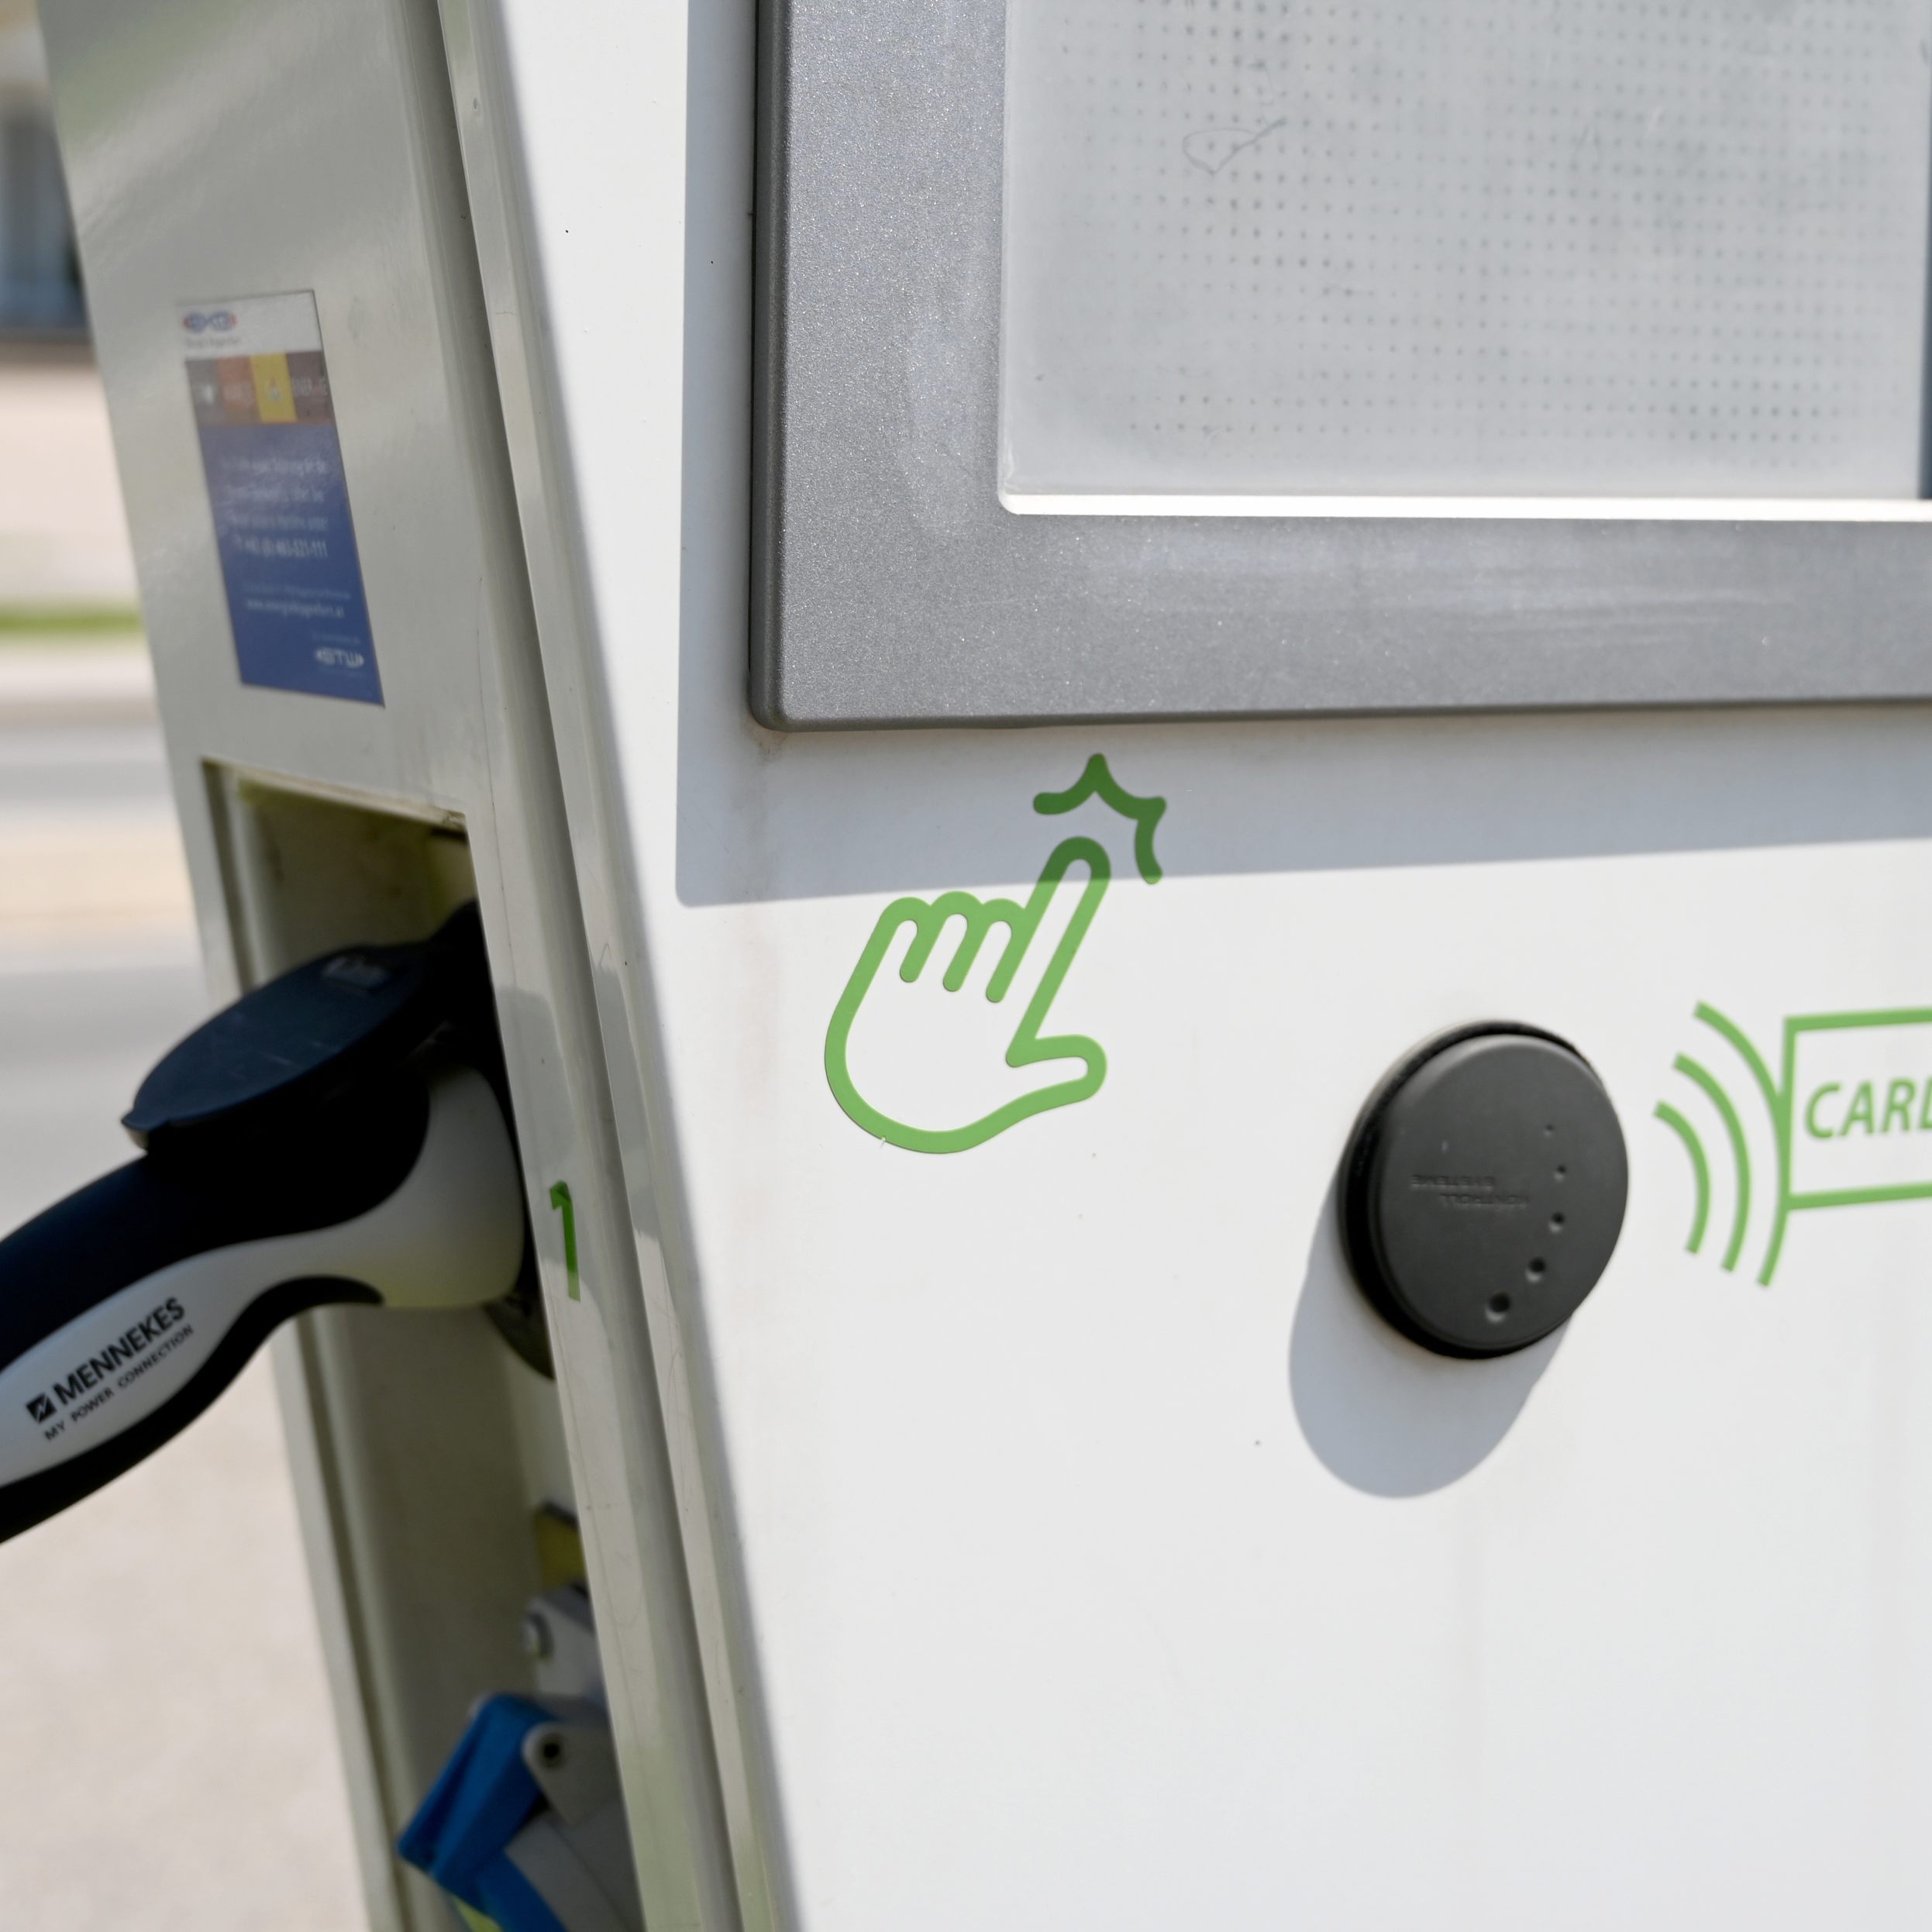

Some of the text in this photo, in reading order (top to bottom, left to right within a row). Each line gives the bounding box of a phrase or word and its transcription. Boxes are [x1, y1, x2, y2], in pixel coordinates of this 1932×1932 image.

[549, 1180, 581, 1303] 1
[43, 1324, 194, 1442] MY POWER CONNECTION
[53, 1297, 184, 1406] MENNEKES
